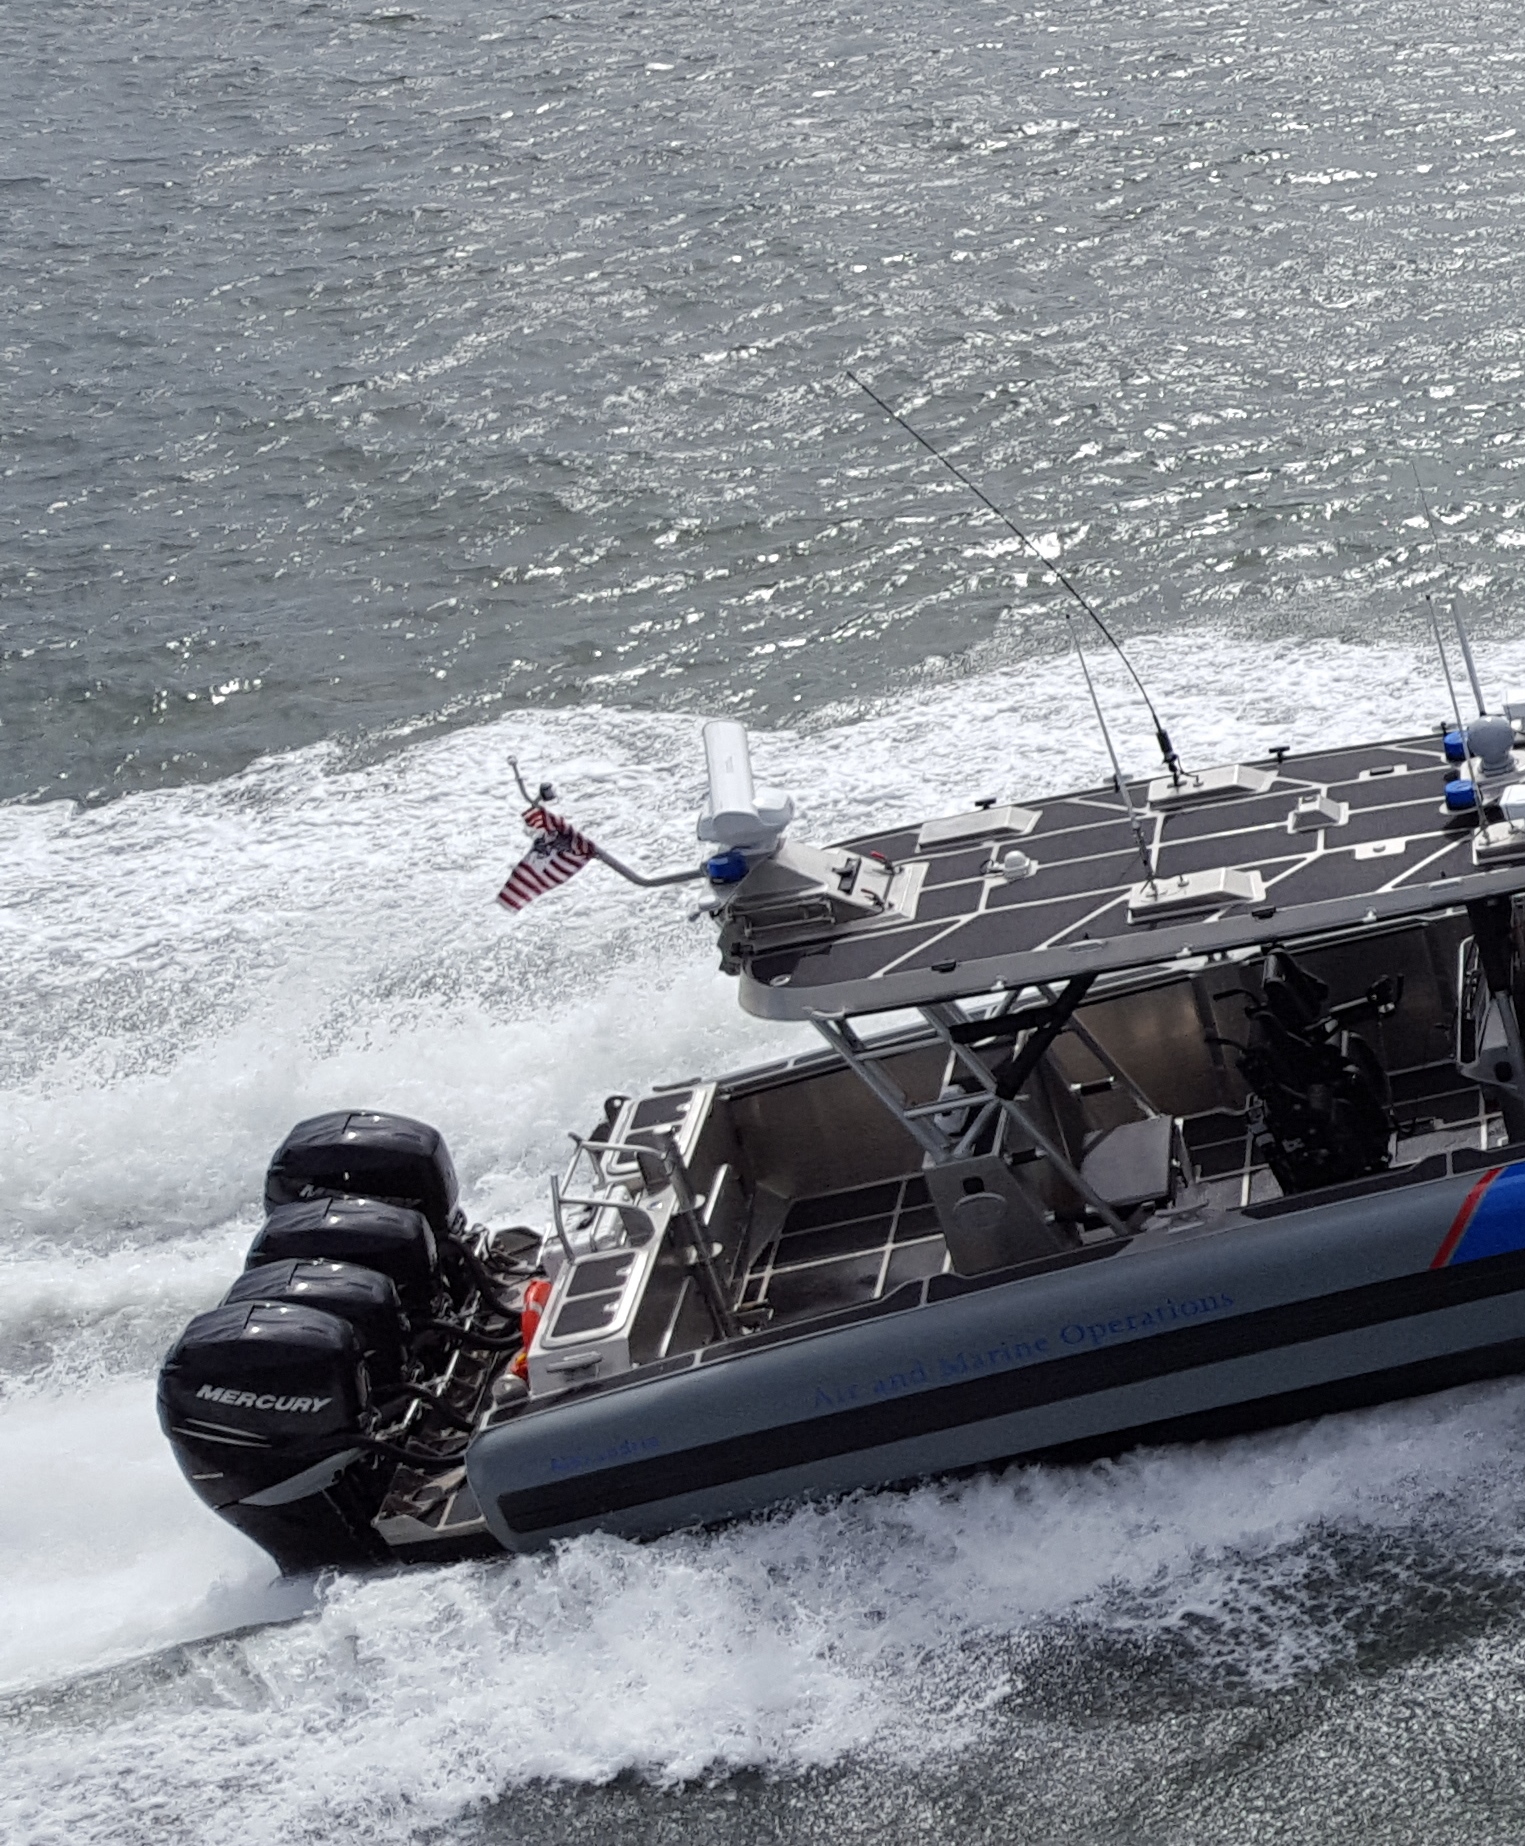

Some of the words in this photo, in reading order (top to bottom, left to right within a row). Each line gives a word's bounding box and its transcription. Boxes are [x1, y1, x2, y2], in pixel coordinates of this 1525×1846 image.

[812, 1382, 858, 1411] Air
[872, 1361, 928, 1396] and
[939, 1334, 1050, 1379] Marine
[1060, 1291, 1235, 1346] Operations
[196, 1384, 332, 1413] MERCURY
